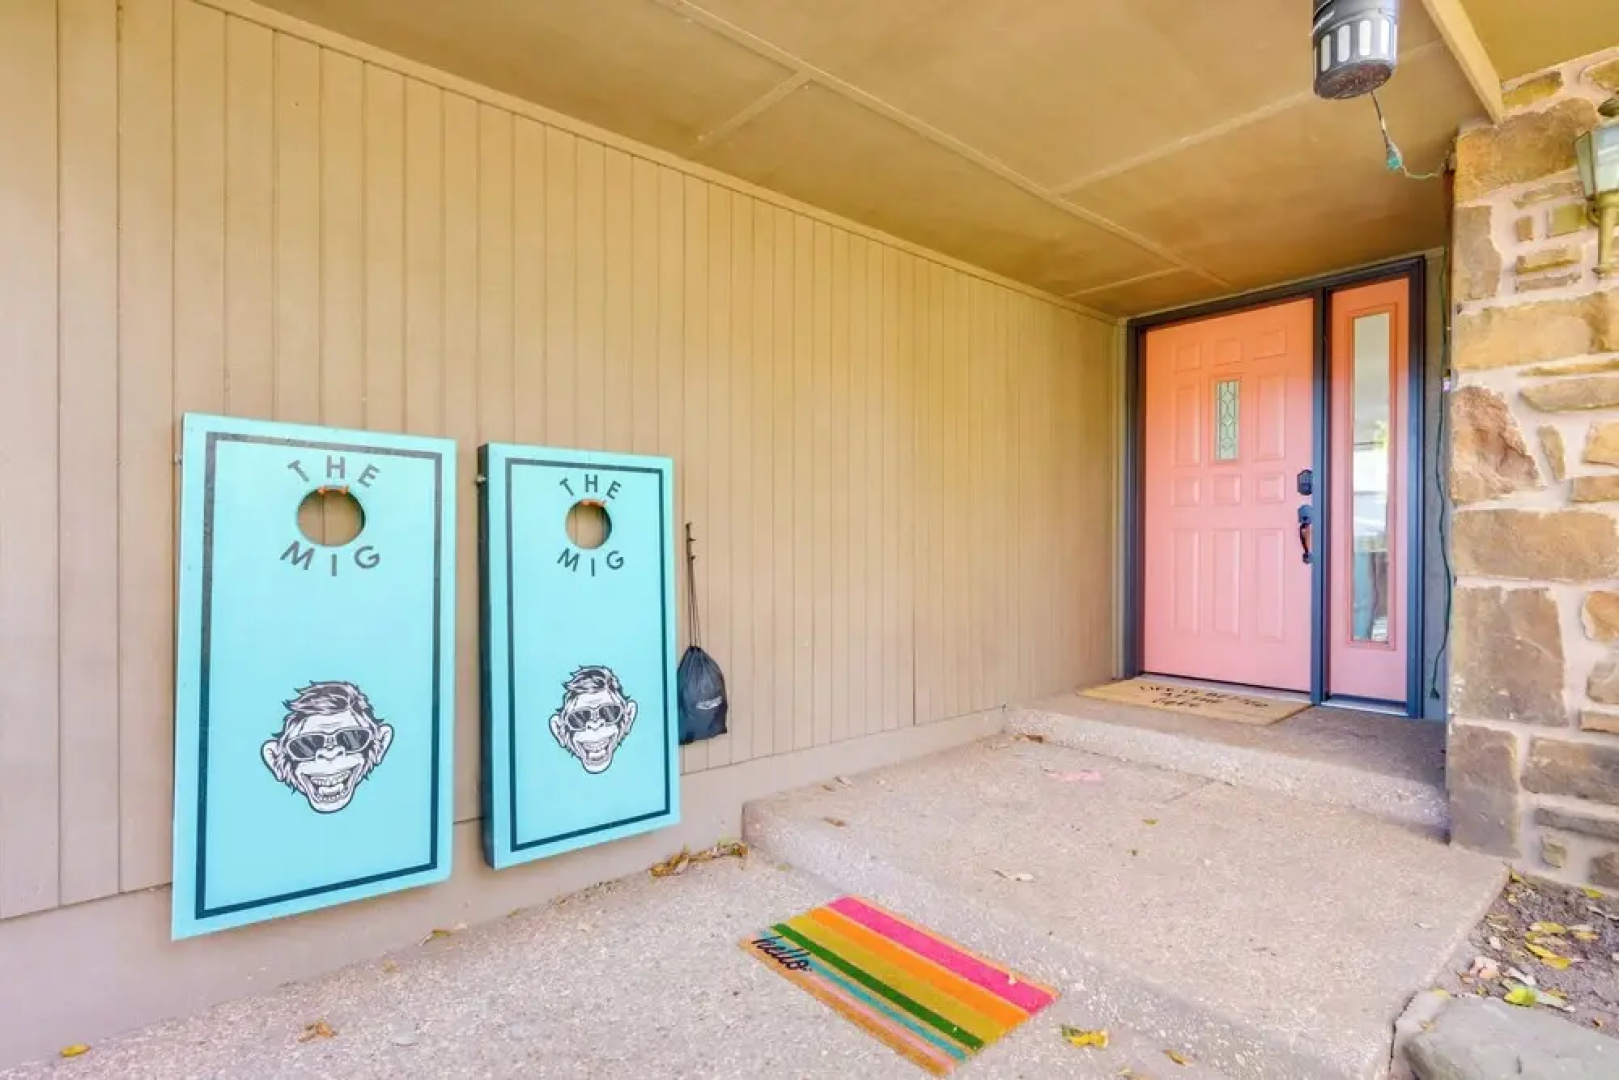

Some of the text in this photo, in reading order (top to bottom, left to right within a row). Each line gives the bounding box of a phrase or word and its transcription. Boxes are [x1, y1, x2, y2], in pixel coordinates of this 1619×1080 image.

[287, 455, 380, 488] THE
[560, 474, 622, 500] THE
[280, 541, 380, 577] MIG
[557, 547, 624, 577] MIG
